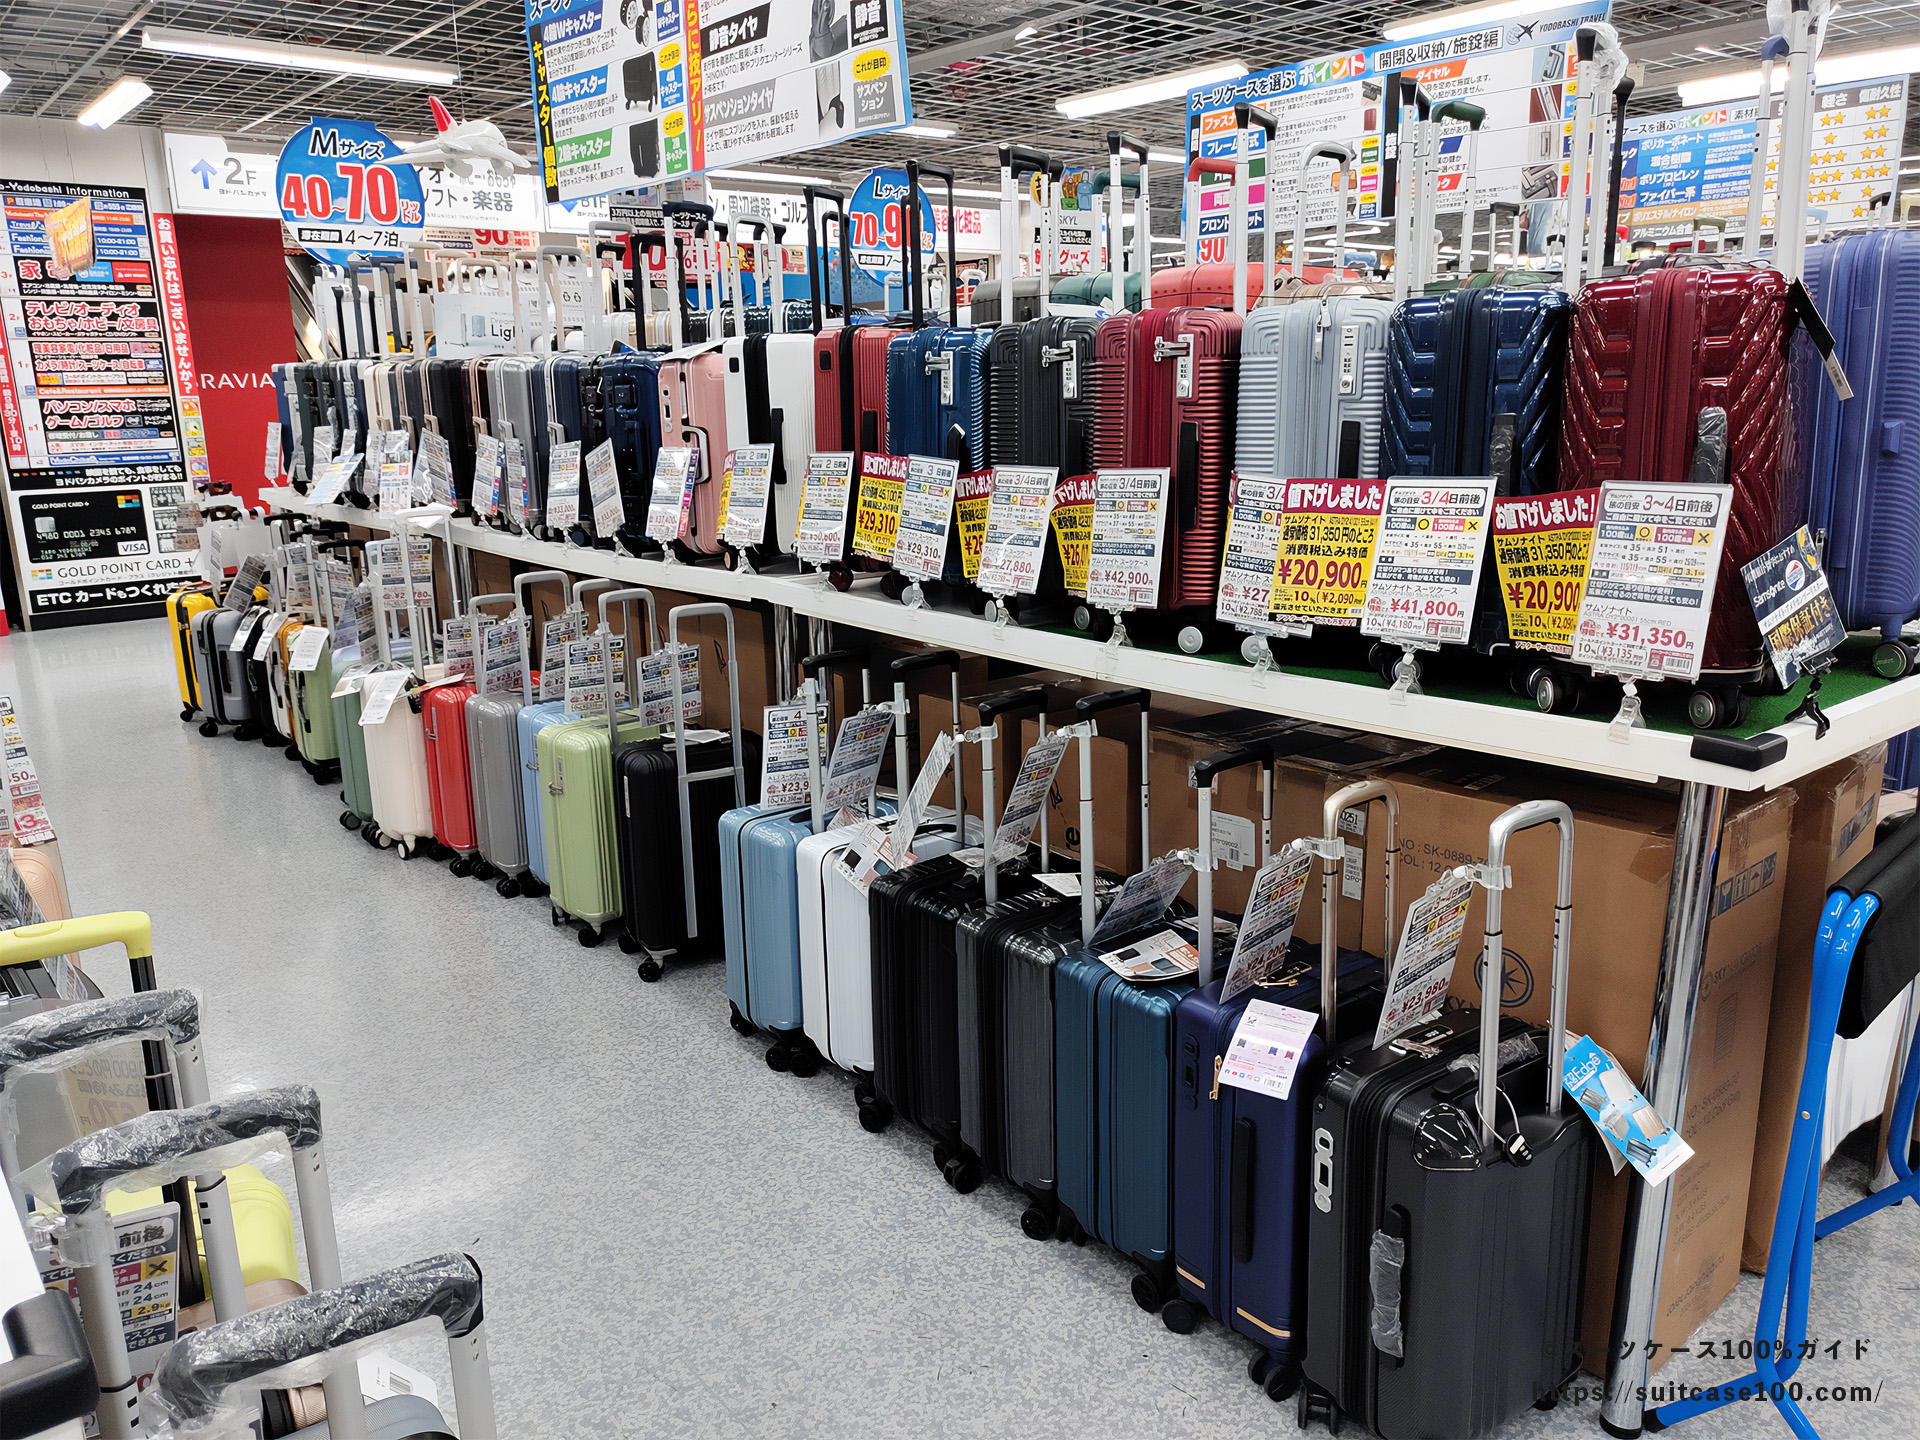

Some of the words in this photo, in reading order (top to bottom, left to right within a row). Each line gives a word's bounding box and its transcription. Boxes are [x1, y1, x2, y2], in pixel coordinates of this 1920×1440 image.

[855, 0, 881, 29] 静音
[543, 10, 602, 43] 4輪Wキャスター
[709, 15, 758, 52] 静音タイヤ
[856, 56, 887, 74] これが目印
[1191, 71, 1297, 111] スーツケースを選ぶ
[1299, 53, 1366, 88] ポイント
[1379, 30, 1499, 70] 開閉&収納/施錠編
[1539, 17, 1579, 33] YODOBASHI
[1580, 12, 1606, 26] TRAVEL
[1416, 67, 1450, 80] ダイヤル
[552, 75, 606, 103] 4輪キャスター
[857, 82, 888, 99] サスペン
[704, 87, 774, 123] サスペンションタイヤ
[861, 97, 884, 112] ション
[1821, 93, 1848, 109] 軽さ
[532, 40, 557, 188] キャスター個数
[1679, 109, 1727, 130] ポイント
[309, 127, 384, 159] Mサイズ
[1641, 133, 1704, 151] ポリカーボネート
[558, 137, 611, 164] 2輪キャスター
[223, 157, 257, 186] 2F
[1639, 169, 1699, 186] ポリプロピレン
[67, 186, 130, 199] Information
[1639, 186, 1697, 203] ファイバー系
[1632, 207, 1697, 223] ポリエステル/ナイロン
[11, 233, 42, 242] Fashion
[345, 230, 399, 248] 4～7泊
[1632, 224, 1693, 239] アルミニウム合金
[14, 245, 44, 254] Fashion
[1200, 238, 1227, 263] 90
[25, 302, 140, 318] テレビ/オーディオ
[157, 217, 192, 394] お買い忘れはございませんか？
[29, 317, 159, 332] おもちゃ/ホビー/文房具
[35, 359, 145, 372] カメラ/時計/スーツケース/自転車
[200, 372, 276, 389] RAVIA
[43, 400, 137, 414] パソコン/スマホ
[45, 415, 124, 429] ゲーム/ゴルフ
[825, 460, 832, 469] 2
[927, 464, 934, 476] 3
[1119, 477, 1158, 490] 3/4日前後
[1240, 489, 1265, 499] 旅の目安
[1287, 482, 1383, 511] 値下げしました
[1393, 497, 1420, 505] 旅の目安
[1421, 490, 1480, 505] 3/4日前後
[1495, 493, 1595, 530] お値下げしました!
[1608, 501, 1640, 510] 旅の目安
[1643, 494, 1713, 513] 3～4日前後
[858, 509, 896, 536] ¥29,310
[1284, 515, 1326, 525] サムソナイト
[1605, 512, 1711, 526] ご自由に開けて中をご覧ください
[115, 527, 136, 535] 6789
[1255, 533, 1265, 541] 37
[1256, 525, 1266, 533] 35
[121, 542, 147, 552] VISA
[1497, 535, 1545, 547] サムソナイト
[1630, 543, 1641, 552] 35
[1284, 543, 1369, 559] 消費税込み特価
[1628, 553, 1639, 562] 35
[1656, 556, 1667, 564] 55
[57, 566, 96, 578] GOLD
[101, 562, 141, 575] POINT
[146, 559, 181, 571] CARD
[1121, 559, 1149, 567] スーツケース
[1225, 569, 1262, 581] サムソナイト
[1508, 564, 1585, 579] 消費税込み特価
[1371, 583, 1412, 591] サムソナイト
[1414, 585, 1458, 595] スーツケース
[1506, 580, 1581, 614] ¥20,900
[1753, 578, 1786, 608] Samsonite
[37, 591, 72, 606] ETC
[1273, 603, 1348, 615] 還元させていただきます
[1584, 611, 1605, 619] ASTRA
[1585, 603, 1633, 616] サムソナイト
[1768, 595, 1832, 652] 国際保証付き
[794, 710, 802, 720] 4
[781, 781, 810, 793] ¥23,9
[1280, 865, 1289, 877] 3
[119, 1224, 165, 1249] 前後
[133, 1279, 169, 1295] 24cm
[133, 1291, 169, 1307] 24cm
[137, 1300, 171, 1316] 2.9kg
